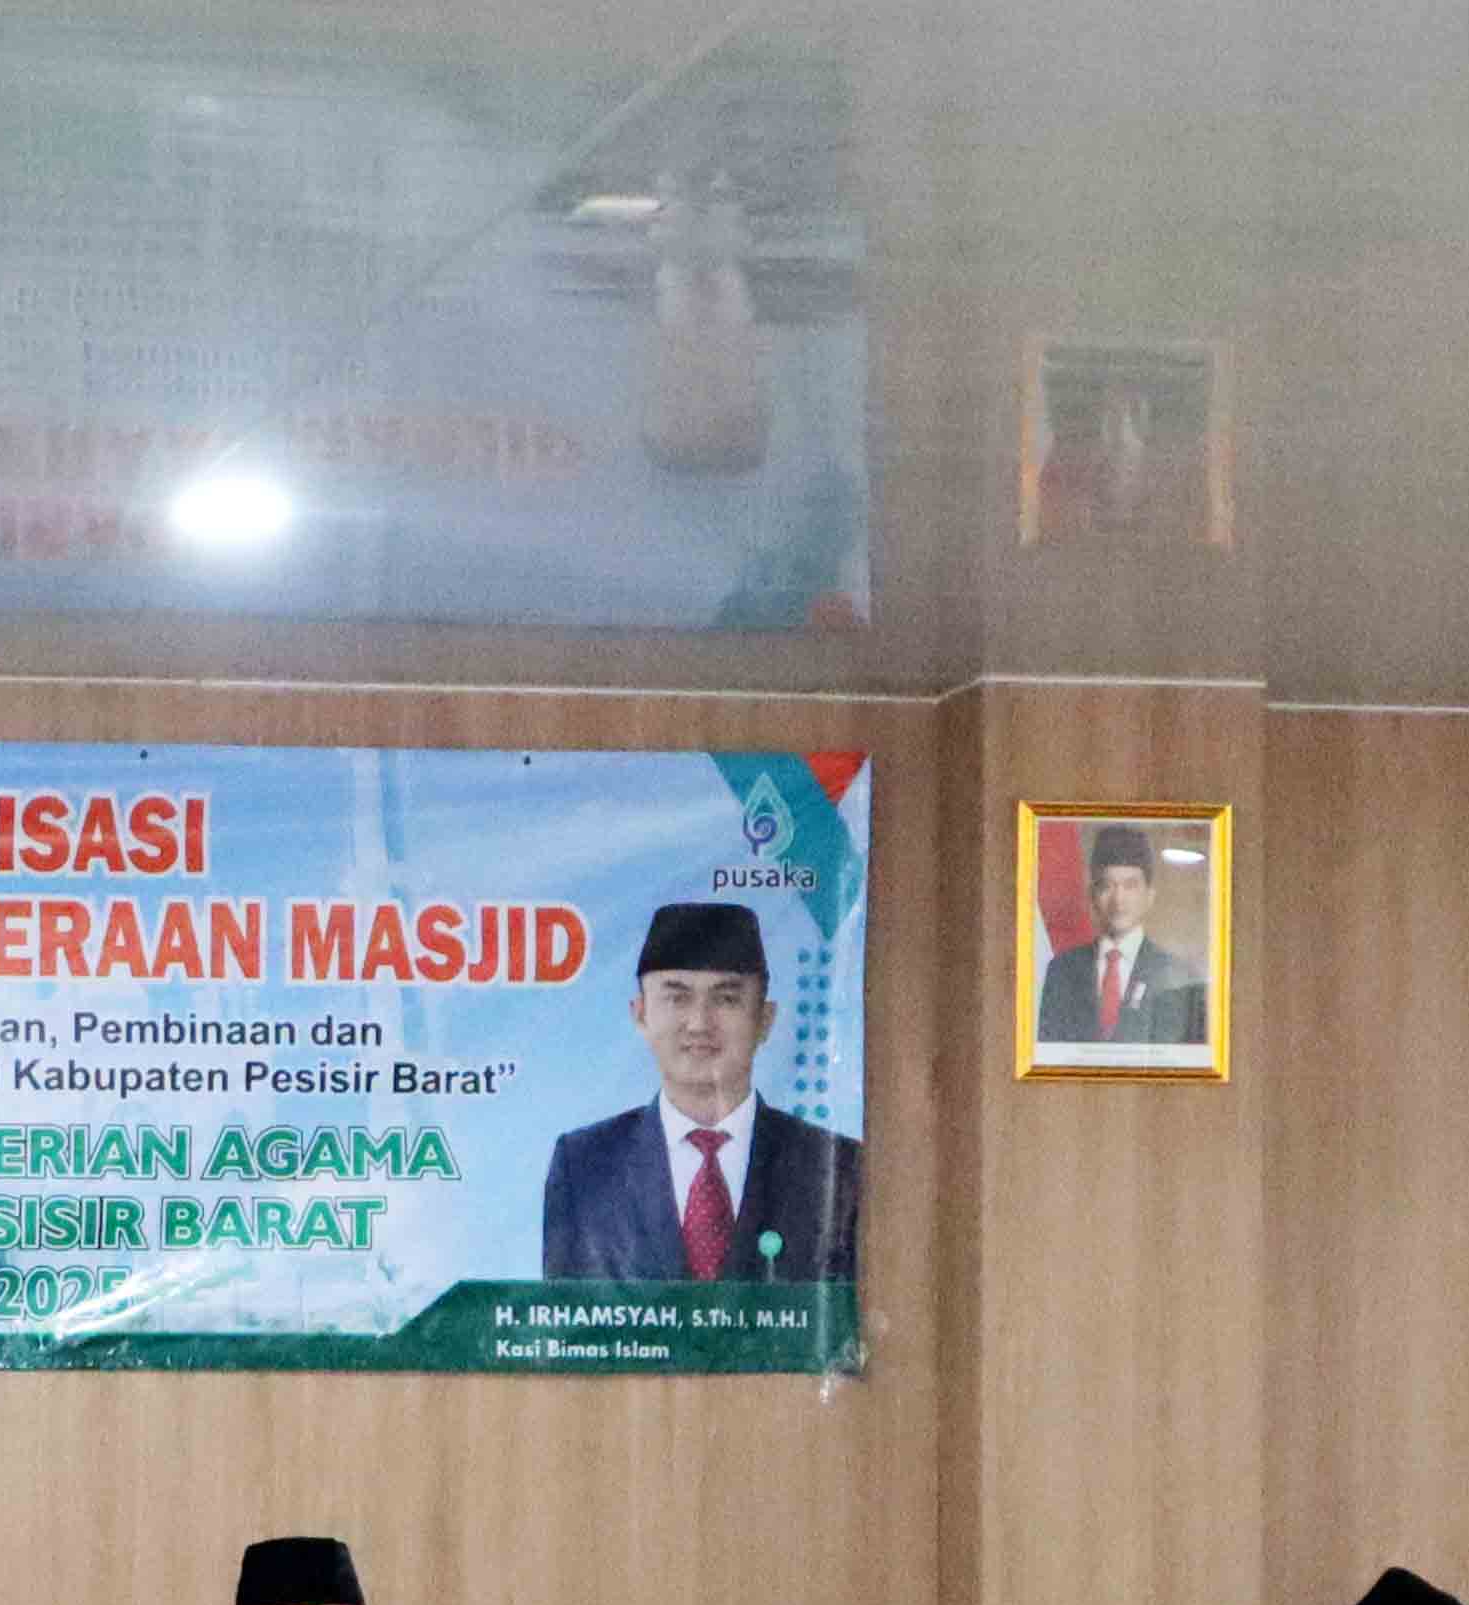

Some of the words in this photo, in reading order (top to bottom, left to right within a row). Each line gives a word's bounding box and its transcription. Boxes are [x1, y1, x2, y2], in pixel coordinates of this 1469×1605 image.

[713, 860, 815, 893] pusaka
[291, 903, 588, 984] MASJID
[73, 1011, 297, 1046] Pembinaan
[310, 1014, 383, 1047] dan
[14, 1060, 229, 1098] Kabupaten
[245, 1061, 381, 1095] Pesisir
[201, 1125, 462, 1181] AGAMA
[159, 1194, 389, 1251] BARAT
[495, 1306, 521, 1327] H.
[528, 1306, 685, 1329] IRHAMSYAH,
[756, 1310, 809, 1328] M.H.I
[495, 1339, 541, 1358] Kasi
[547, 1339, 609, 1359] Bimas
[616, 1340, 670, 1359] Islam
